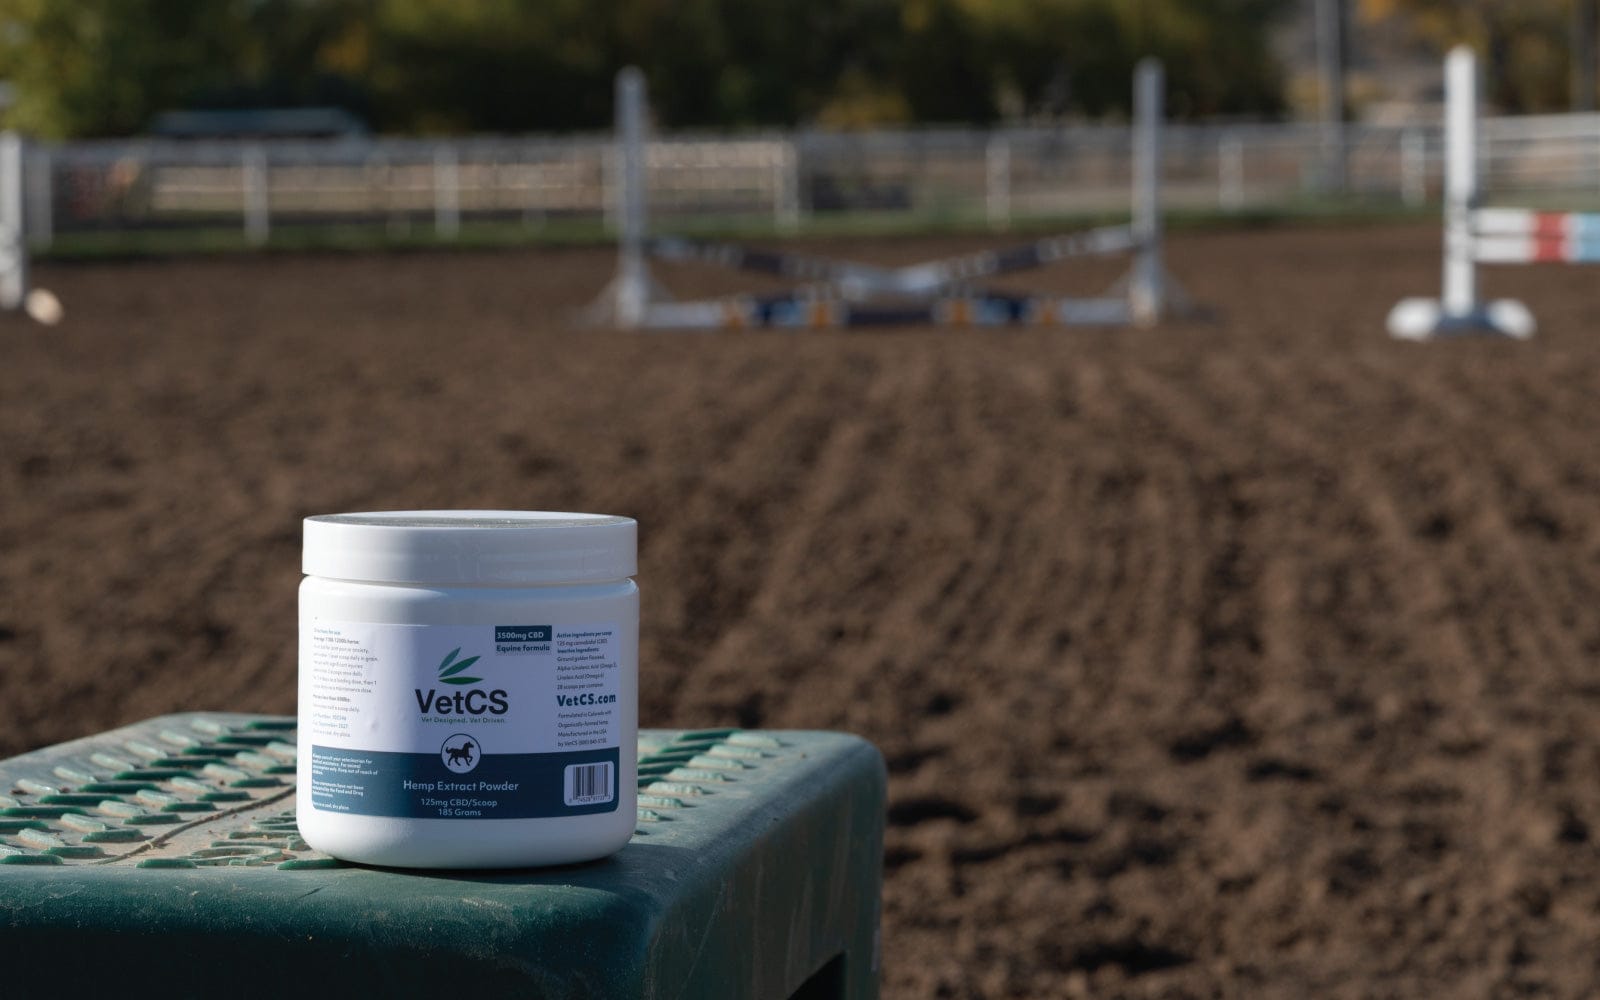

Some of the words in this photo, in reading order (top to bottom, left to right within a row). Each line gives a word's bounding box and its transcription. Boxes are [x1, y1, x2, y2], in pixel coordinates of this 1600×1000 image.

[496, 631, 527, 640] 3500mg
[528, 631, 544, 639] CBD
[496, 644, 521, 653] Equine
[414, 688, 509, 715] VetCS
[556, 692, 616, 707] VetCS.com
[403, 780, 435, 792] Hemp
[437, 781, 477, 791] Extract
[480, 781, 519, 791] Powder
[421, 798, 448, 808] 125mg
[450, 799, 498, 808] CBD/Scoop
